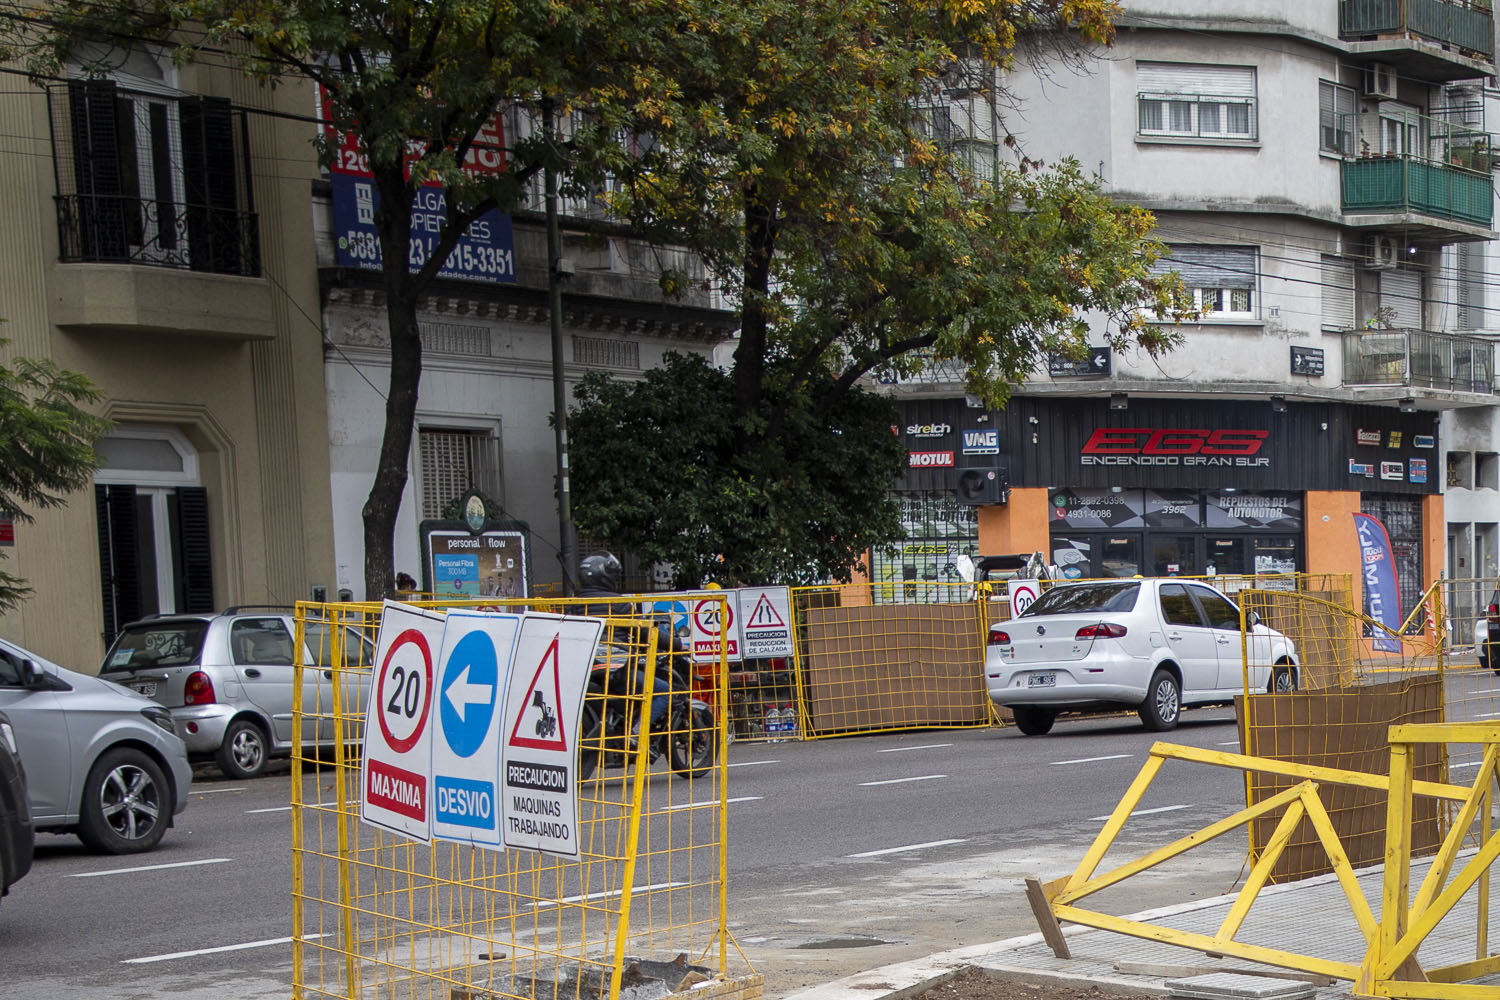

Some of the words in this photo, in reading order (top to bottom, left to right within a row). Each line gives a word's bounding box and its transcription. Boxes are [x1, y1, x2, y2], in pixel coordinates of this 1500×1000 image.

[906, 423, 951, 434] stretch
[1081, 428, 1269, 455] EGS
[909, 453, 952, 465] MOTUL
[1081, 456, 1179, 466] ENCENDIDO
[1183, 456, 1233, 466] GRAN
[1236, 457, 1270, 467] SUR
[1219, 496, 1271, 507] REPUESTOS
[1271, 497, 1288, 508] DEL
[1161, 505, 1186, 514] 3962
[1227, 507, 1283, 519] AUTOMOTOR
[447, 538, 480, 550] personal
[488, 538, 506, 549] flow
[747, 630, 786, 639] PRECAUCION
[750, 639, 786, 647] REDUCCION
[749, 646, 758, 655] DE
[758, 645, 788, 654] CALZADA
[388, 665, 421, 719] 20
[508, 765, 566, 788] PRECAUCION
[371, 772, 422, 810] MAXIMA
[438, 786, 491, 819] DESVIO
[513, 795, 561, 818] MAQUINAS
[508, 816, 570, 840] TRABAJANDO
